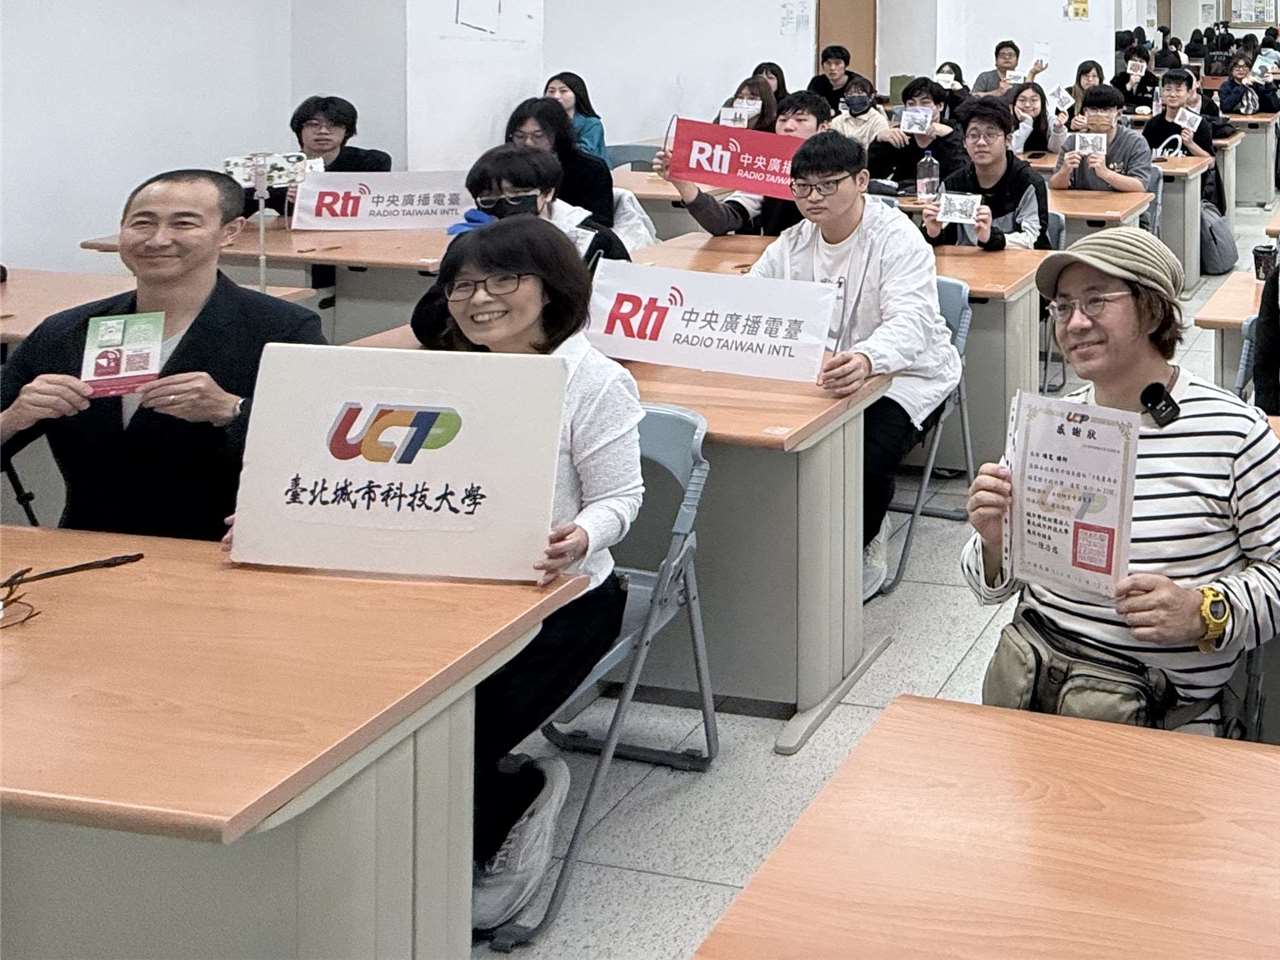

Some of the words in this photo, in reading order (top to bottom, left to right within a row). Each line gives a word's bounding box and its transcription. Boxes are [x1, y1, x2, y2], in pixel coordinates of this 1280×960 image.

[689, 140, 731, 175] Rti
[737, 169, 765, 181] RADIO
[314, 191, 362, 218] Rti
[368, 209, 400, 217] RADIO
[440, 208, 460, 216] INTL
[371, 193, 461, 207] 中央廣播電臺
[604, 292, 670, 342] Rti
[681, 307, 804, 341] 中央廣播電臺
[672, 333, 714, 349] RADIO
[715, 338, 766, 355] TAIWAN
[767, 344, 795, 358] INTL
[284, 473, 487, 515] 臺北城市科技大學
